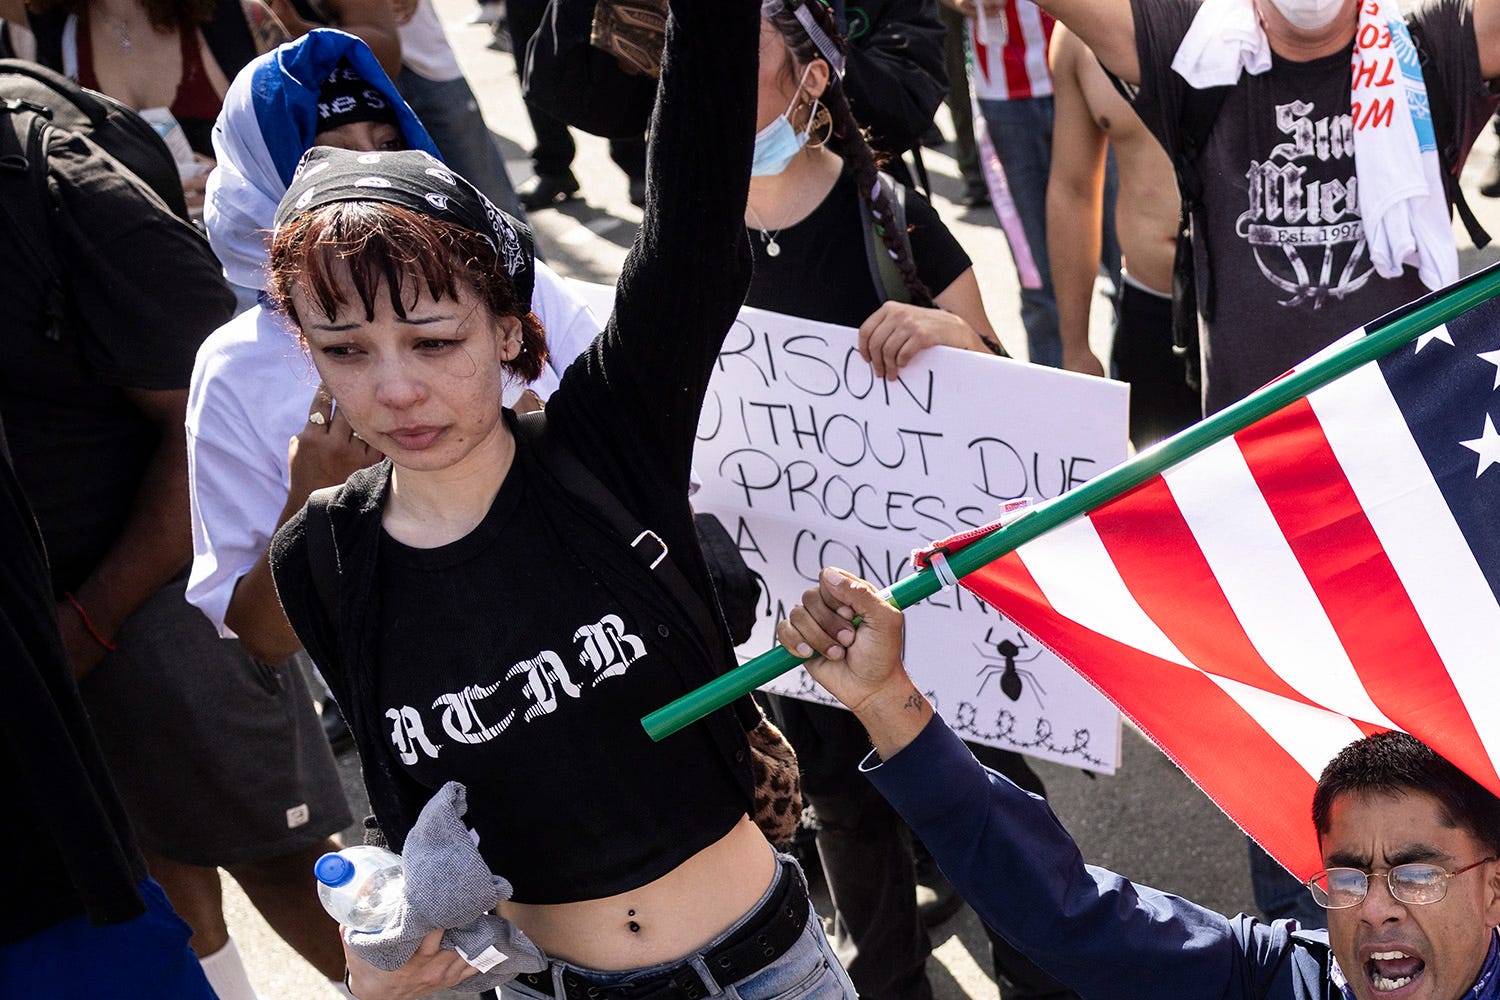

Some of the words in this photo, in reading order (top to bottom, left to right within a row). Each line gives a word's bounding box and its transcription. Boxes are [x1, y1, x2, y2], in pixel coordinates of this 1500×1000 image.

[1278, 229, 1313, 244] Est.
[1321, 222, 1361, 242] 1997
[718, 318, 935, 414] RISON
[735, 515, 768, 564] A
